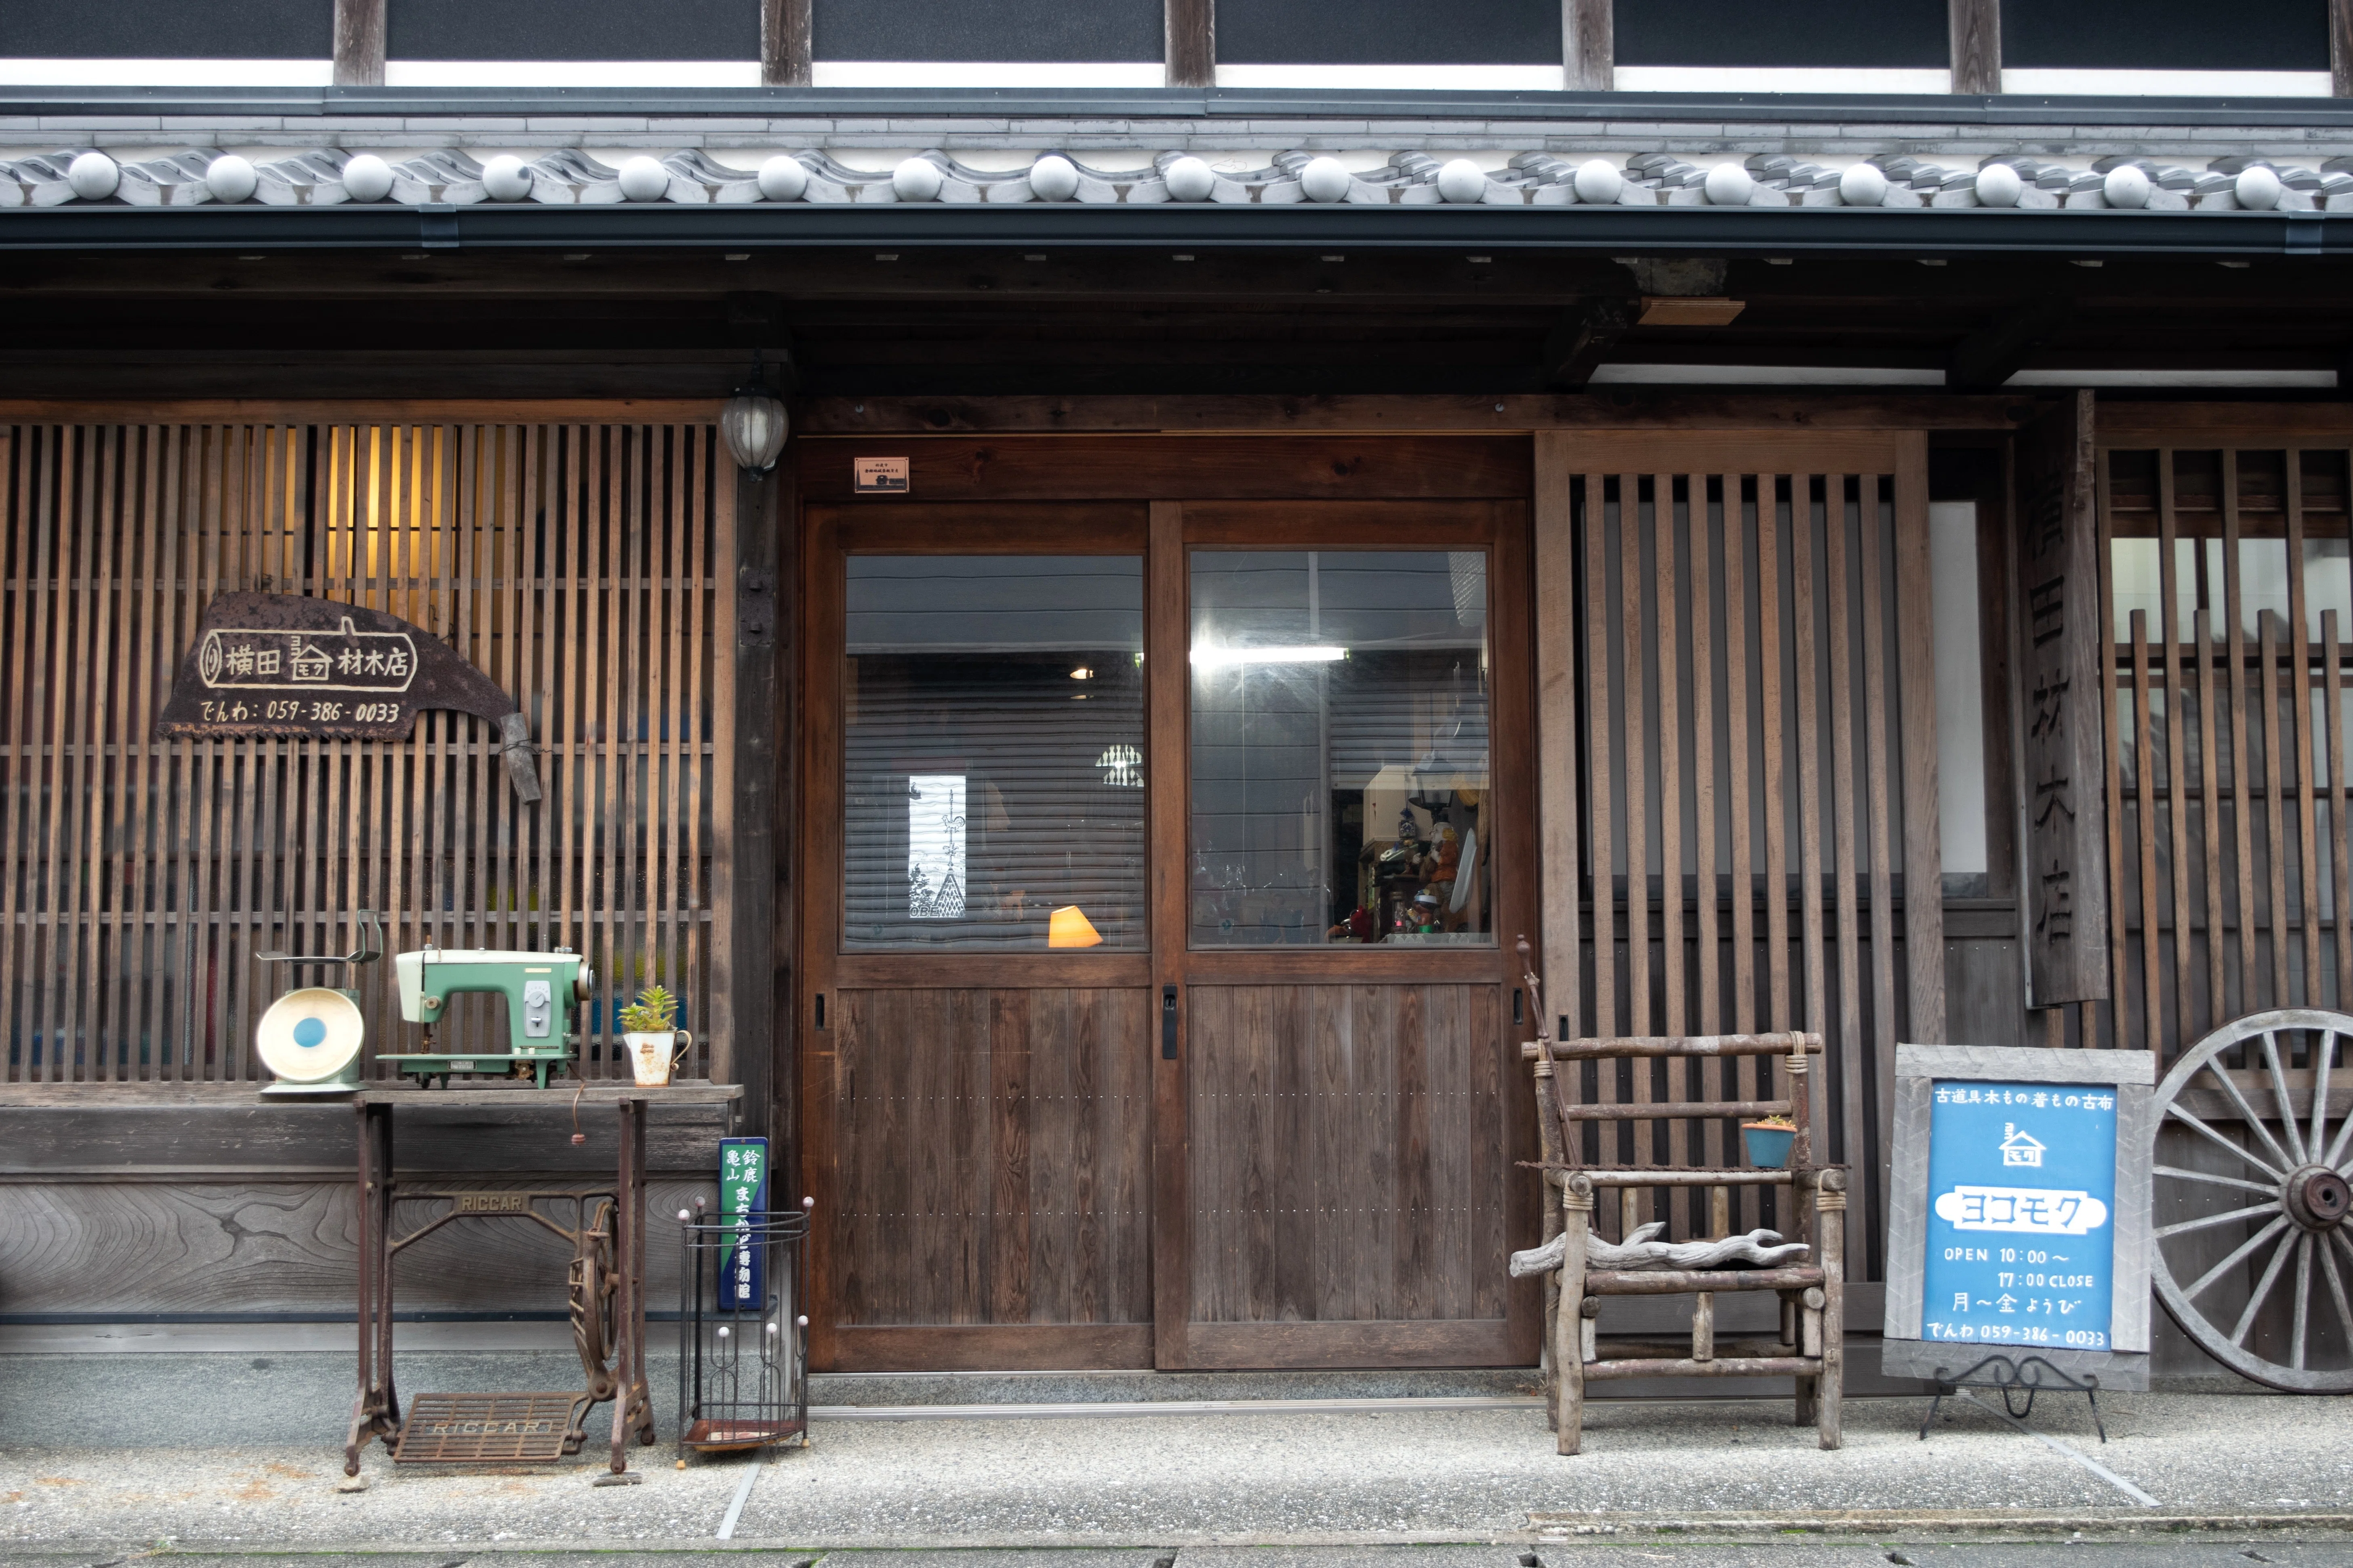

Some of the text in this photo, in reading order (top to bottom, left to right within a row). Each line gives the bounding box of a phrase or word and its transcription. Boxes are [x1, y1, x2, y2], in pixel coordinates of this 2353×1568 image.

[225, 644, 408, 676] 横田 材木店
[299, 664, 324, 677] モク
[267, 700, 399, 723] 059-386-0033
[726, 1150, 741, 1181] 亀山
[743, 1150, 760, 1183] 鈴鹿
[462, 1196, 522, 1211] RICCAR
[1962, 1194, 2083, 1229] ヨコモク
[1945, 1247, 1988, 1261] OPEN
[1998, 1272, 2093, 1288] 17:00 CLOSE
[2027, 1298, 2081, 1314] ようび
[1927, 1322, 1974, 1338] でんわ
[433, 1422, 539, 1433] RICCAR
